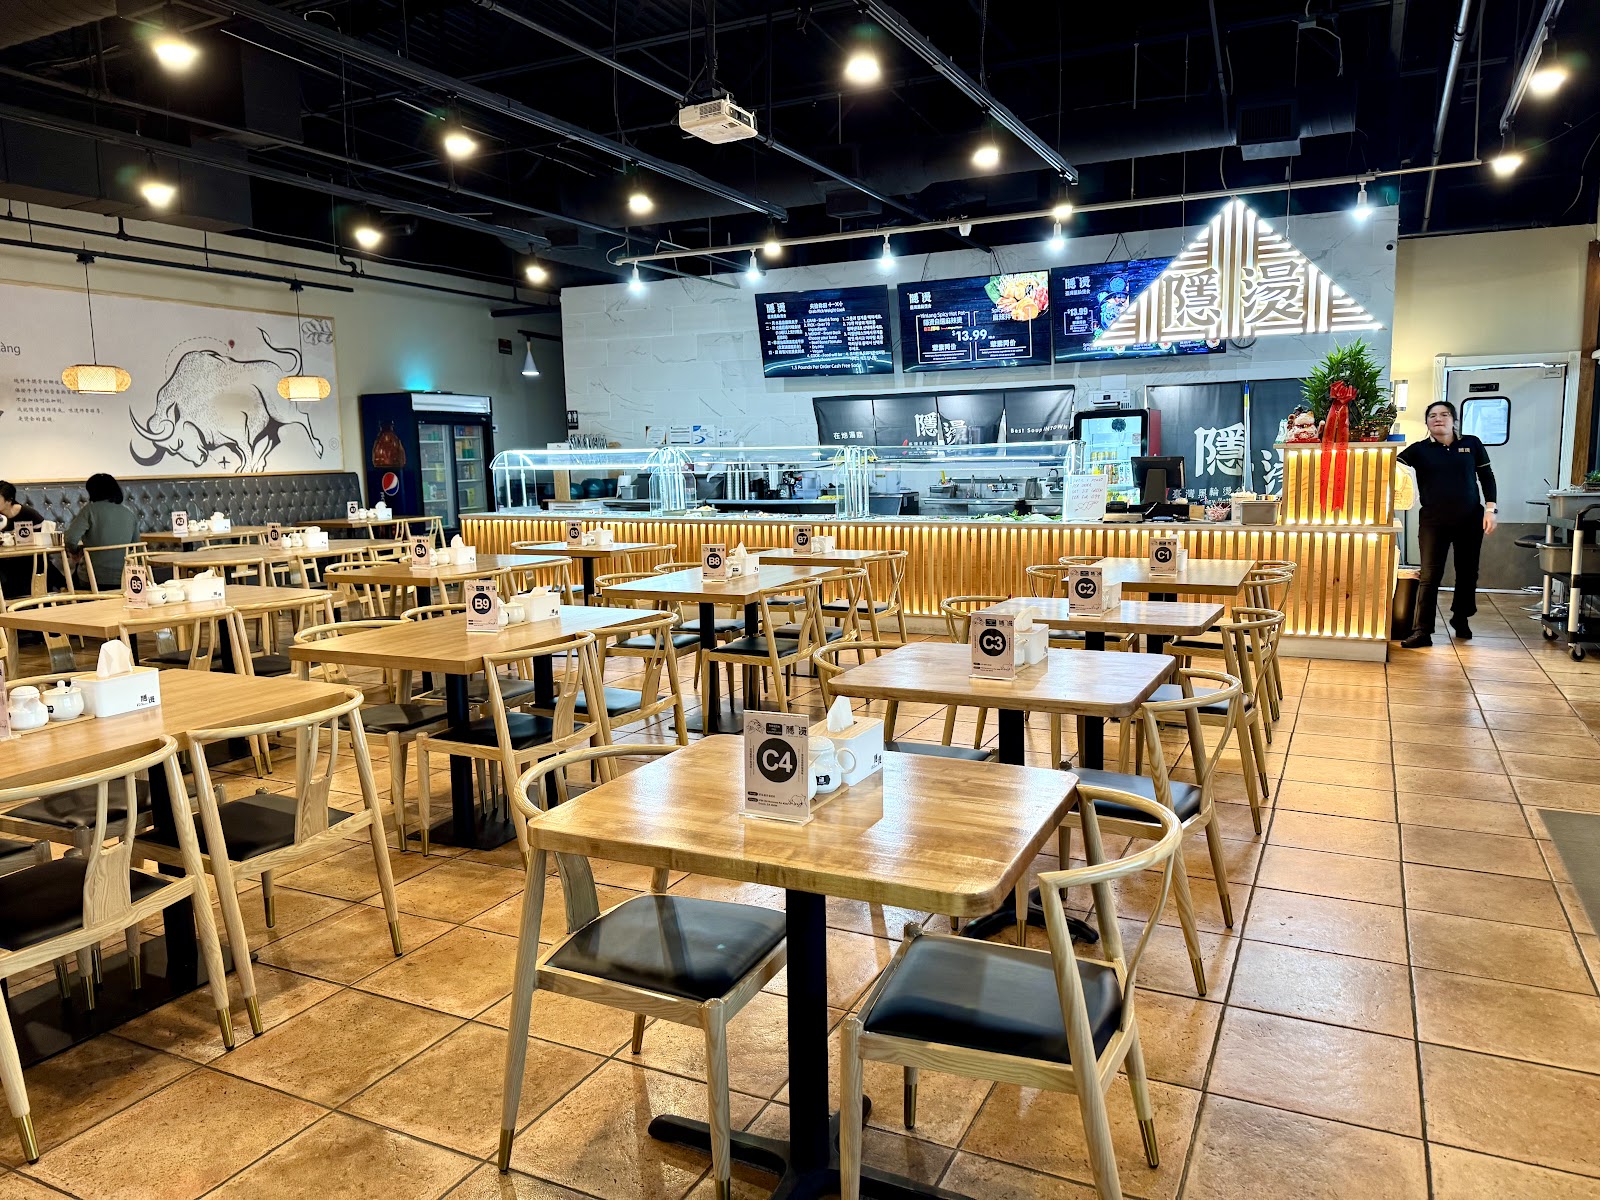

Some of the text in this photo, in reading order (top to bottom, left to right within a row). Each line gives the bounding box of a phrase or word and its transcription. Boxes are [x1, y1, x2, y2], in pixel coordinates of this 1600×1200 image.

[1163, 260, 1304, 329] 隱燙
[952, 329, 987, 341] $13.99
[570, 529, 579, 537] B3
[798, 535, 807, 543] B7
[416, 547, 425, 555] B4
[1157, 550, 1170, 559] C1
[708, 557, 720, 566] B8
[1078, 583, 1094, 594] C2
[474, 599, 489, 610] B9
[983, 635, 1003, 650] C3
[762, 749, 793, 773] C4
